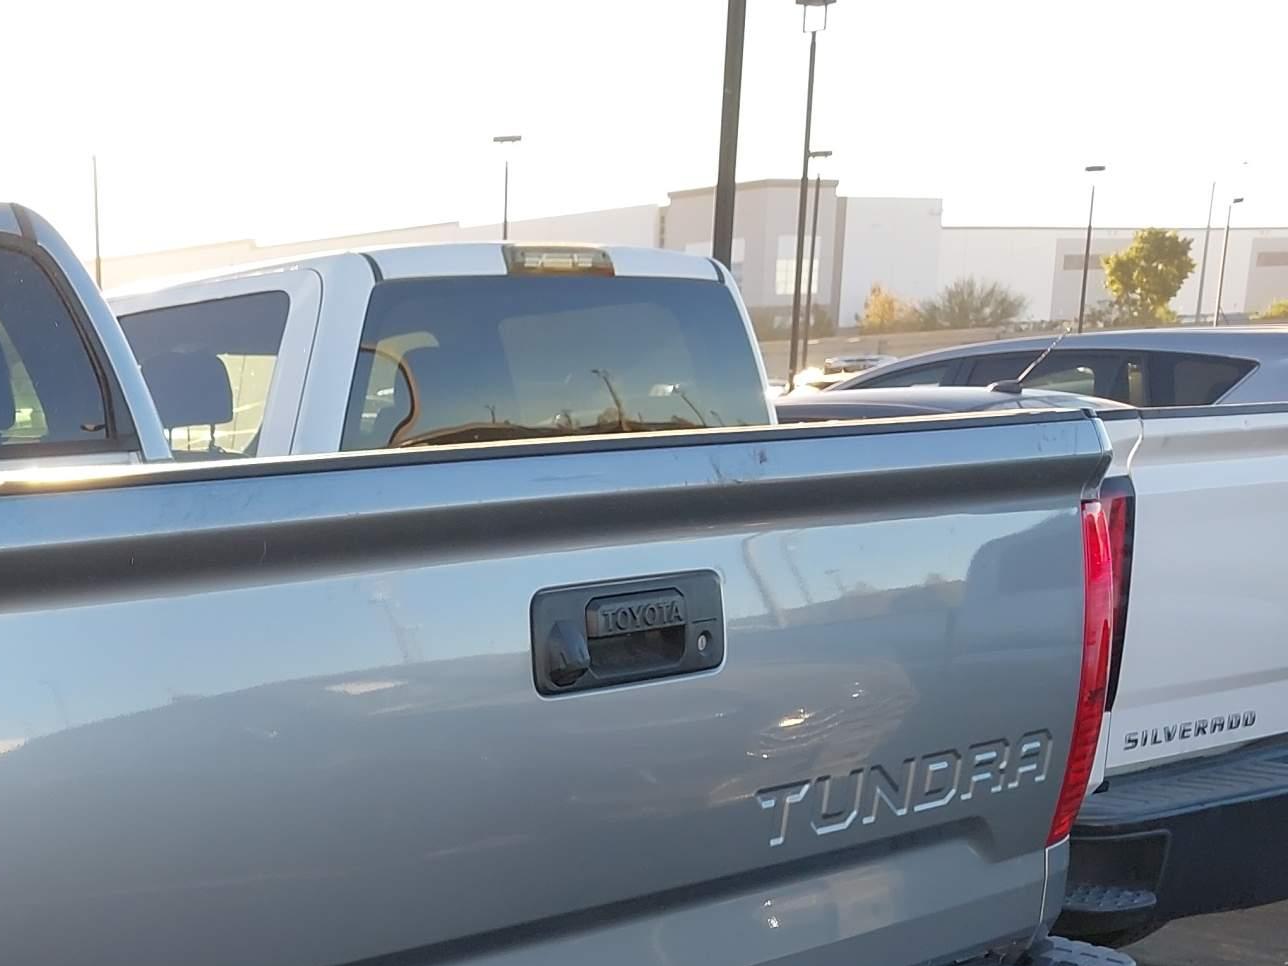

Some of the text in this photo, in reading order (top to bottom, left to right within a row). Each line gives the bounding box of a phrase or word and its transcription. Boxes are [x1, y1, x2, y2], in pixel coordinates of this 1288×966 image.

[601, 600, 684, 632] TOYOTA
[1123, 710, 1257, 751] SILVERADO
[753, 728, 1053, 847] TUNDRA
